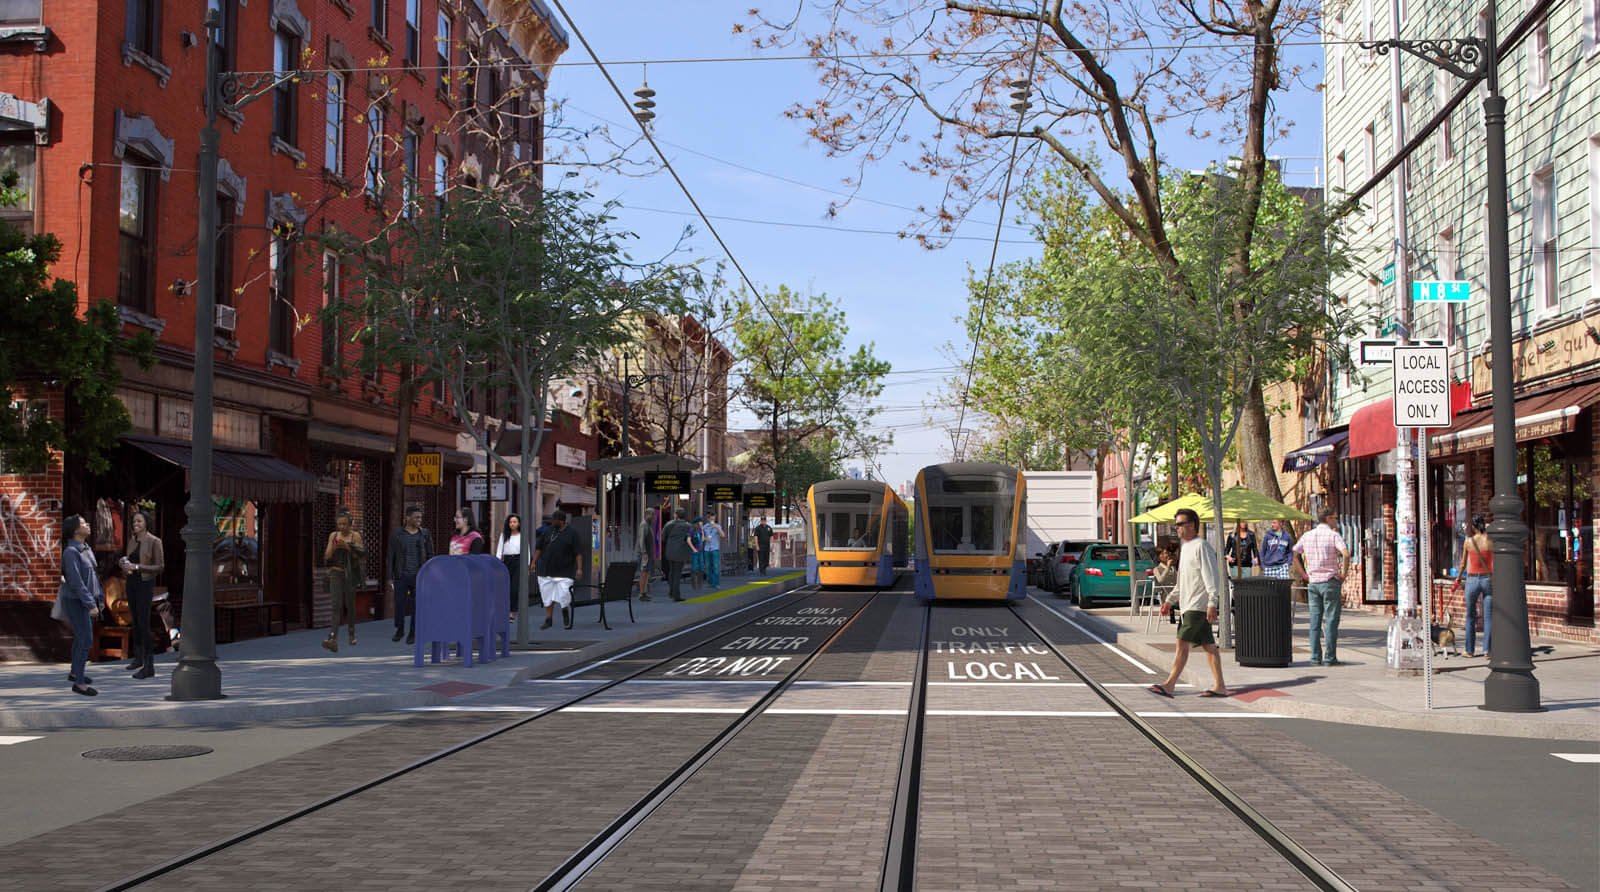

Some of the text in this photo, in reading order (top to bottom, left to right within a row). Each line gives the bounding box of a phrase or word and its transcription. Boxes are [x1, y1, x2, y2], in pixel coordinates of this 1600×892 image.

[1420, 283, 1430, 299] N
[1403, 355, 1440, 369] LOCAL
[1399, 380, 1446, 394] ACCESS
[1407, 404, 1438, 418] ONLY
[408, 473, 432, 483] WINE
[797, 607, 843, 615] ONLY
[756, 616, 849, 625] STREETCAR
[952, 626, 1009, 637] ONLY
[720, 637, 810, 650] ENTER
[932, 641, 1049, 655] TRAFFIC
[664, 656, 792, 676] DO NOT
[946, 661, 1060, 680] LOCAL
